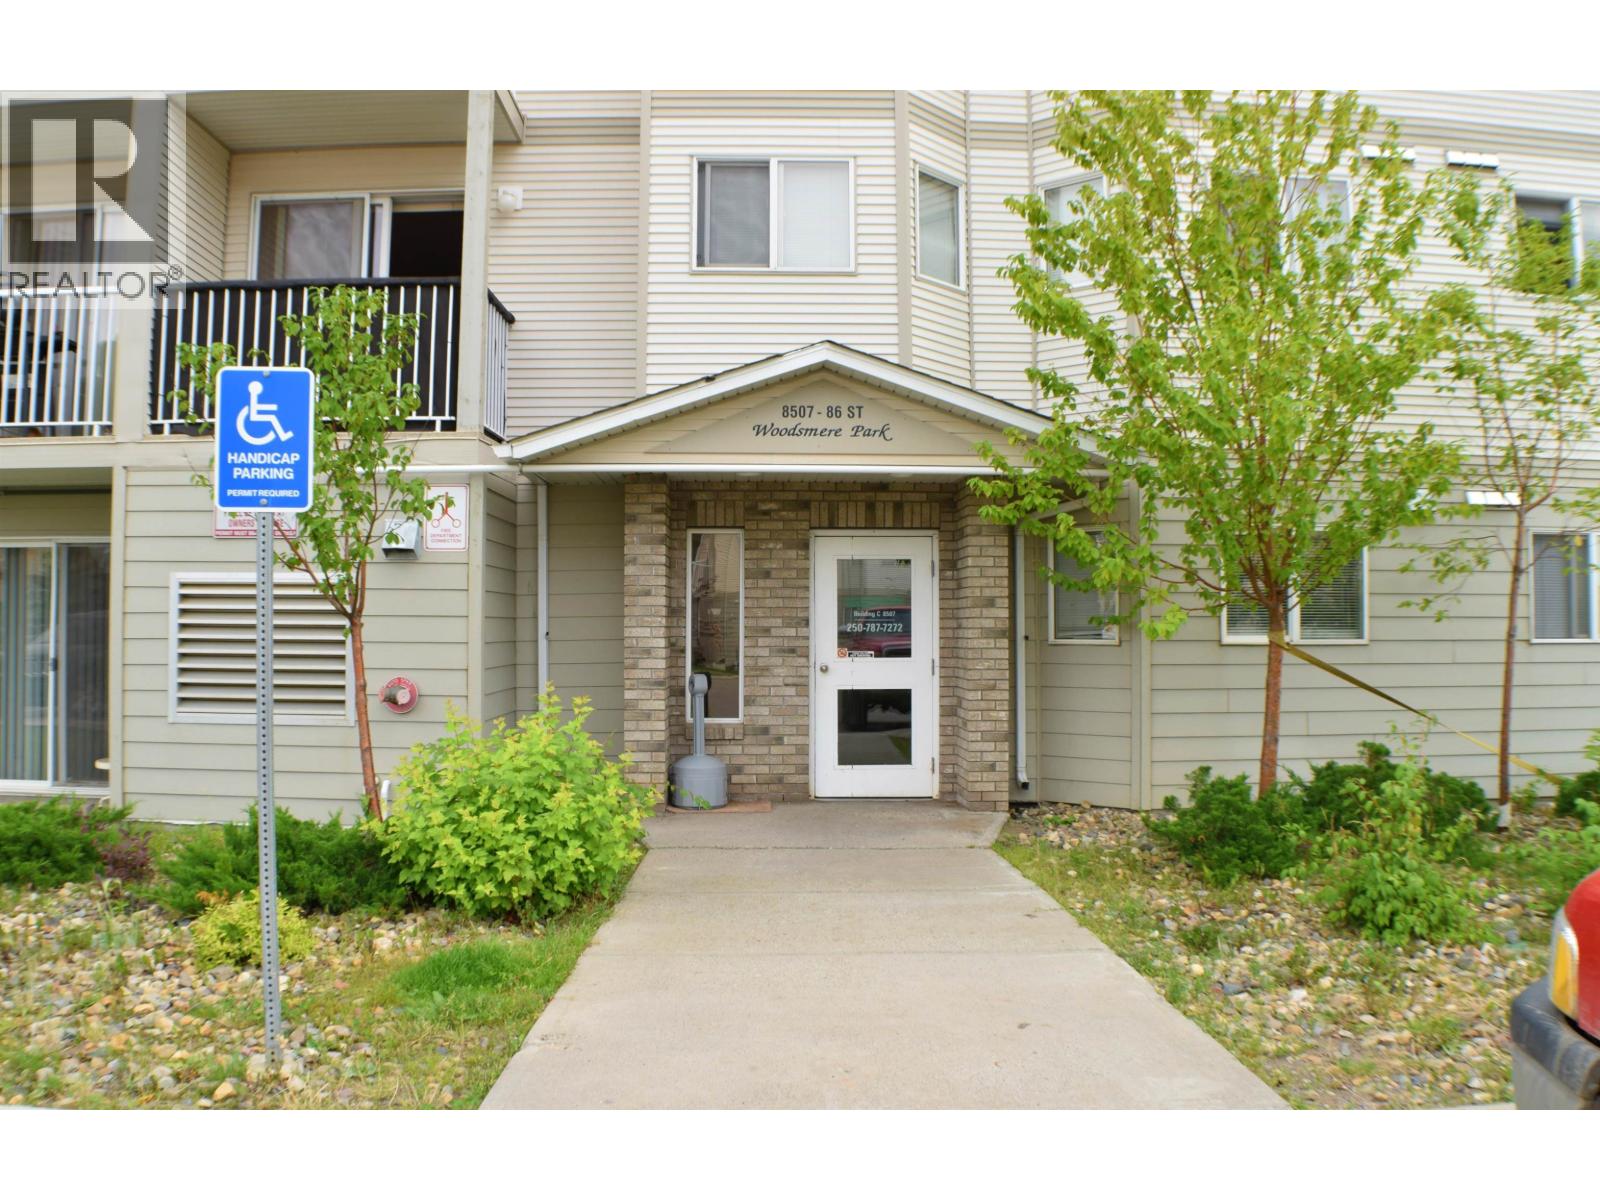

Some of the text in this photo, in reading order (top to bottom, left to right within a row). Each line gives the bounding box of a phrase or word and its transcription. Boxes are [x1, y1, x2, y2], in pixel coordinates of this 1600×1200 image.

[782, 405, 814, 418] 8507
[826, 405, 842, 418] 86
[847, 405, 864, 418] ST
[752, 422, 893, 442] Woodsmere Park
[227, 452, 300, 464] HANDICAP
[233, 467, 294, 479] PARKING
[258, 489, 300, 497] REQUIRED
[846, 623, 903, 632] 250-787-7272
